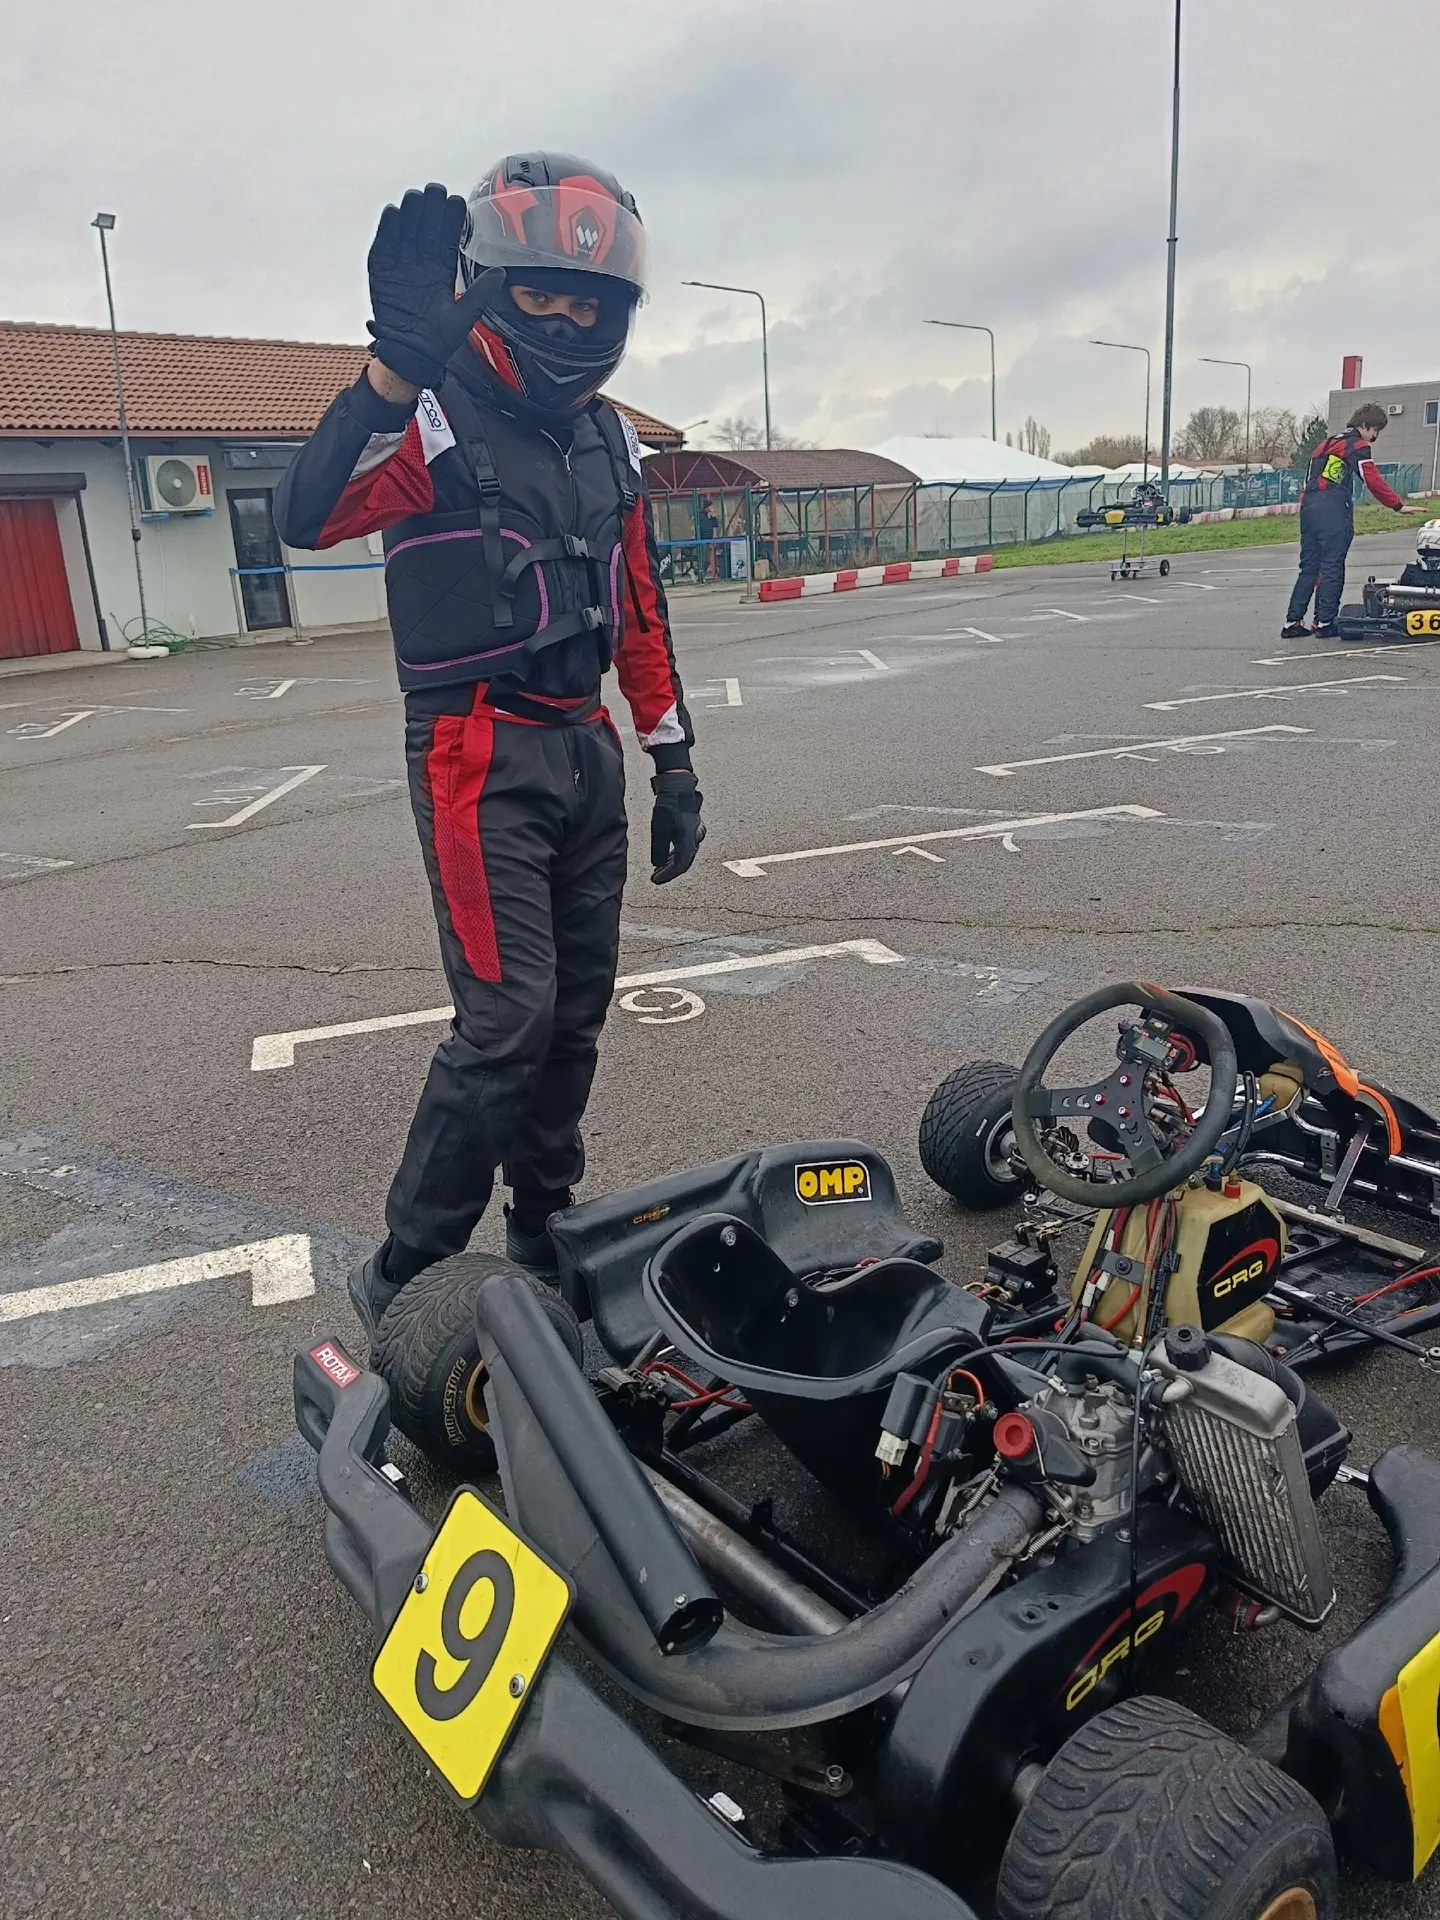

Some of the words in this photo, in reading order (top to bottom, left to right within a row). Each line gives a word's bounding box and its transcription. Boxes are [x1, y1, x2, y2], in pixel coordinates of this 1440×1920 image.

[1411, 613, 1440, 631] 36
[1113, 742, 1226, 763] 15
[192, 785, 269, 806] 18
[891, 831, 1022, 863] 17
[799, 1166, 865, 1198] OMP
[1213, 1260, 1264, 1298] CRG
[315, 1346, 356, 1384] ROTAX
[415, 1548, 516, 1722] 9
[1066, 1609, 1165, 1711] CRG
